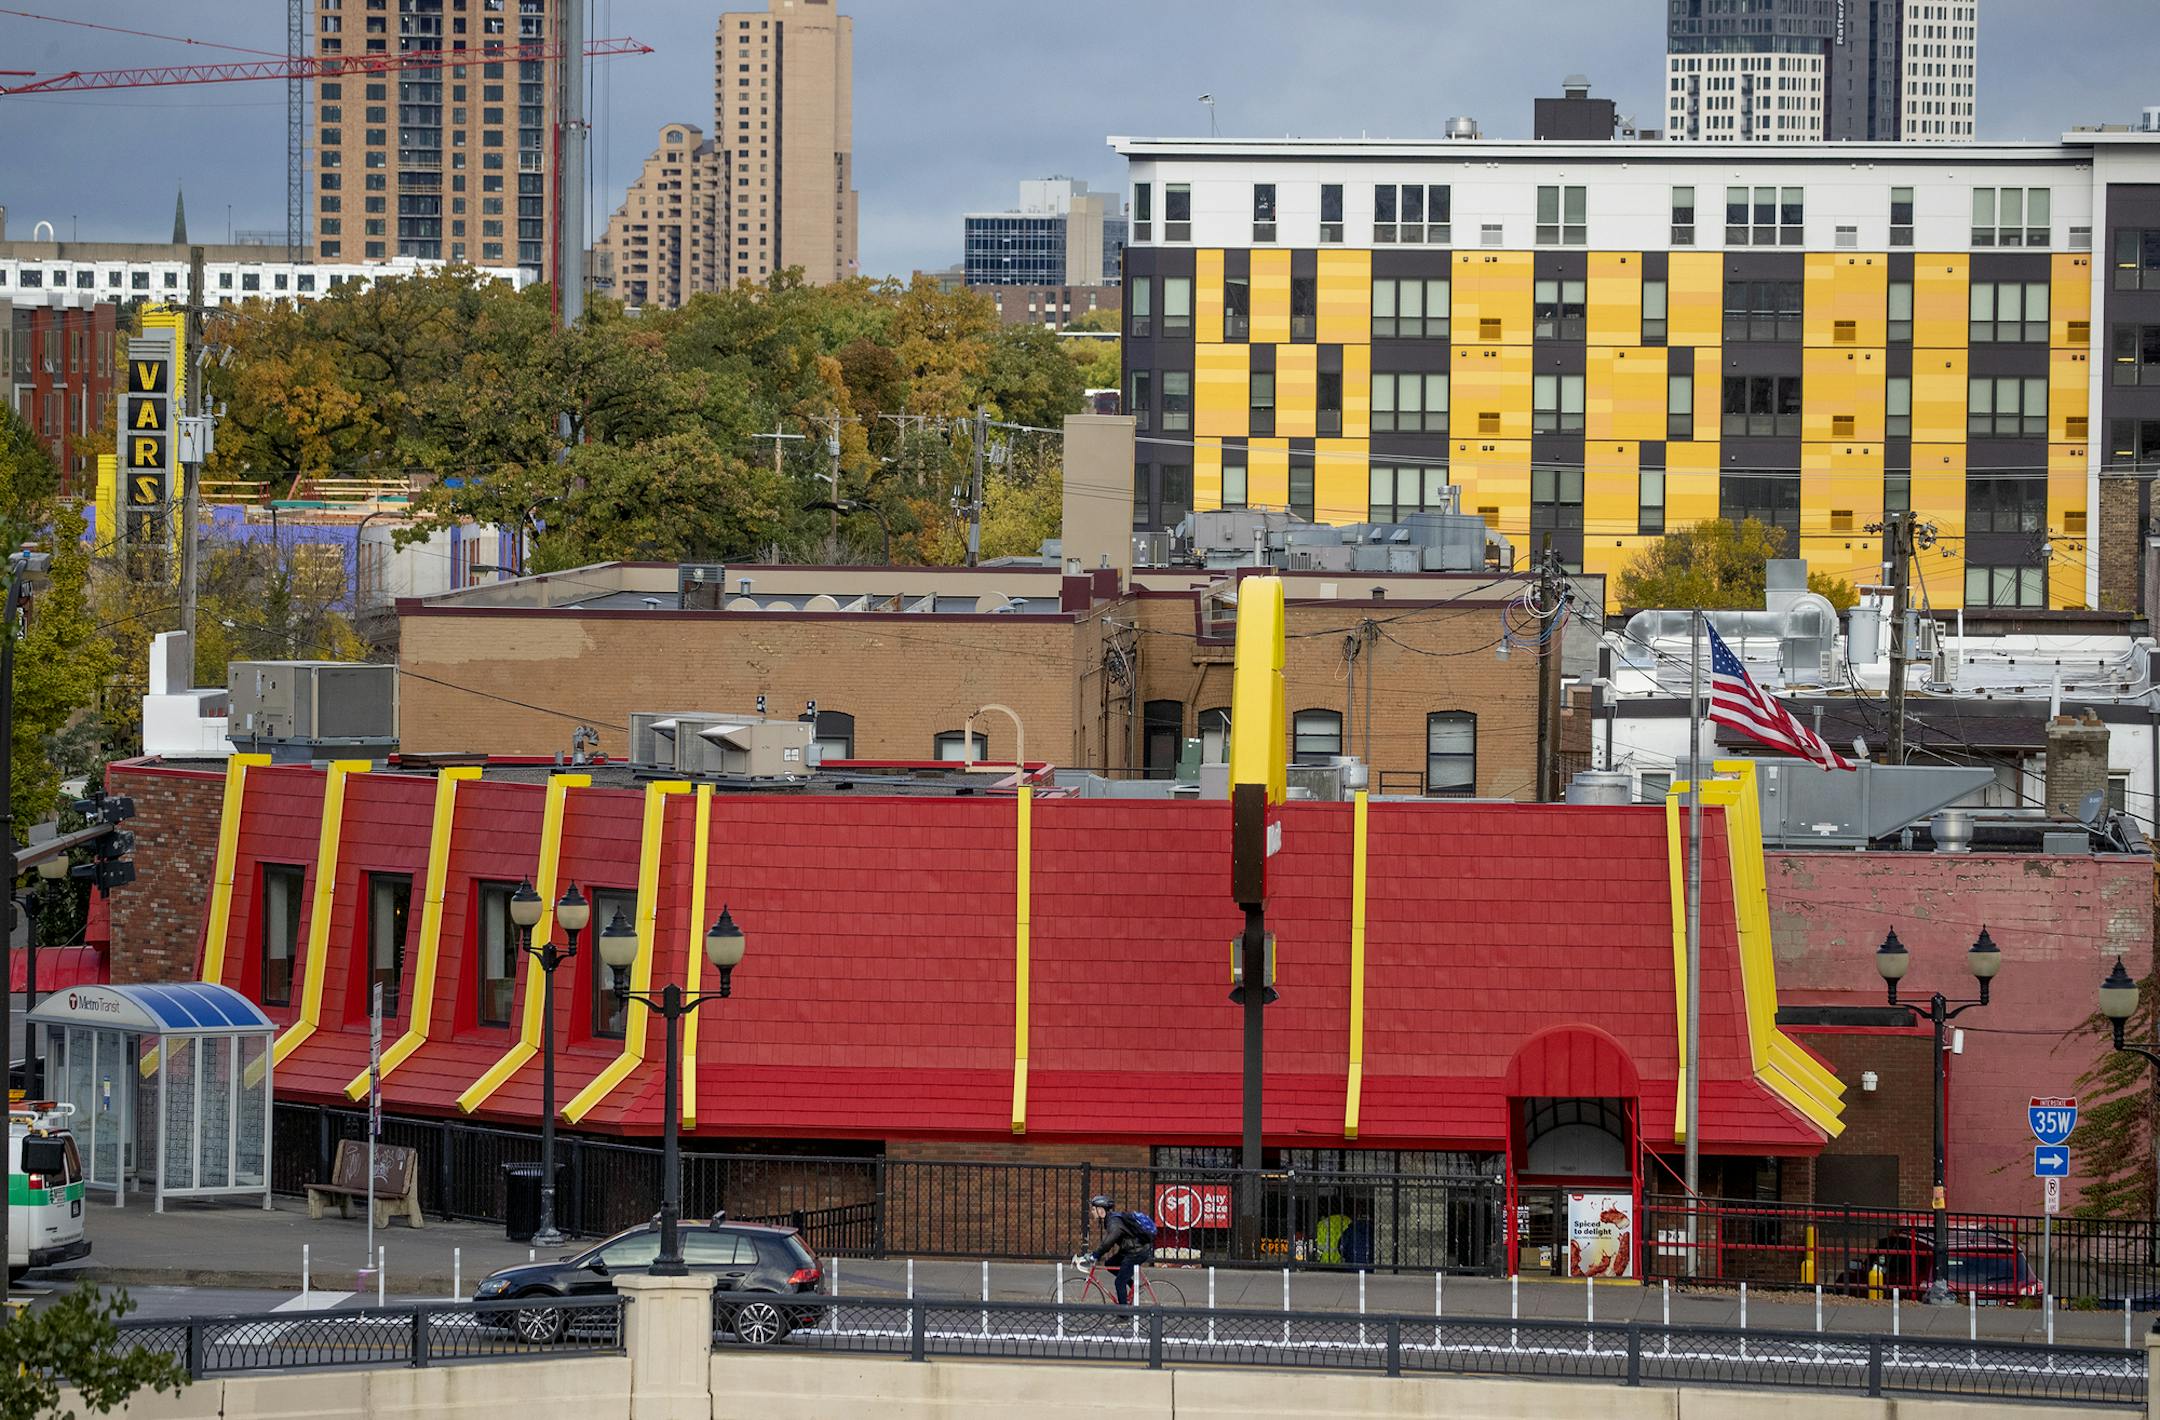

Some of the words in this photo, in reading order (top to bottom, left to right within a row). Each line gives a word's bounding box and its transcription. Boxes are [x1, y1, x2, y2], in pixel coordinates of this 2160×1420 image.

[2035, 1111, 2071, 1134] 35W
[1204, 1193, 1226, 1205] Any
[1166, 1194, 1192, 1223] $1
[1204, 1203, 1228, 1213] Size
[1574, 1220, 1601, 1229] Spiced
[1583, 1228, 1612, 1237] delight
[1260, 1242, 1289, 1255] OPEN
